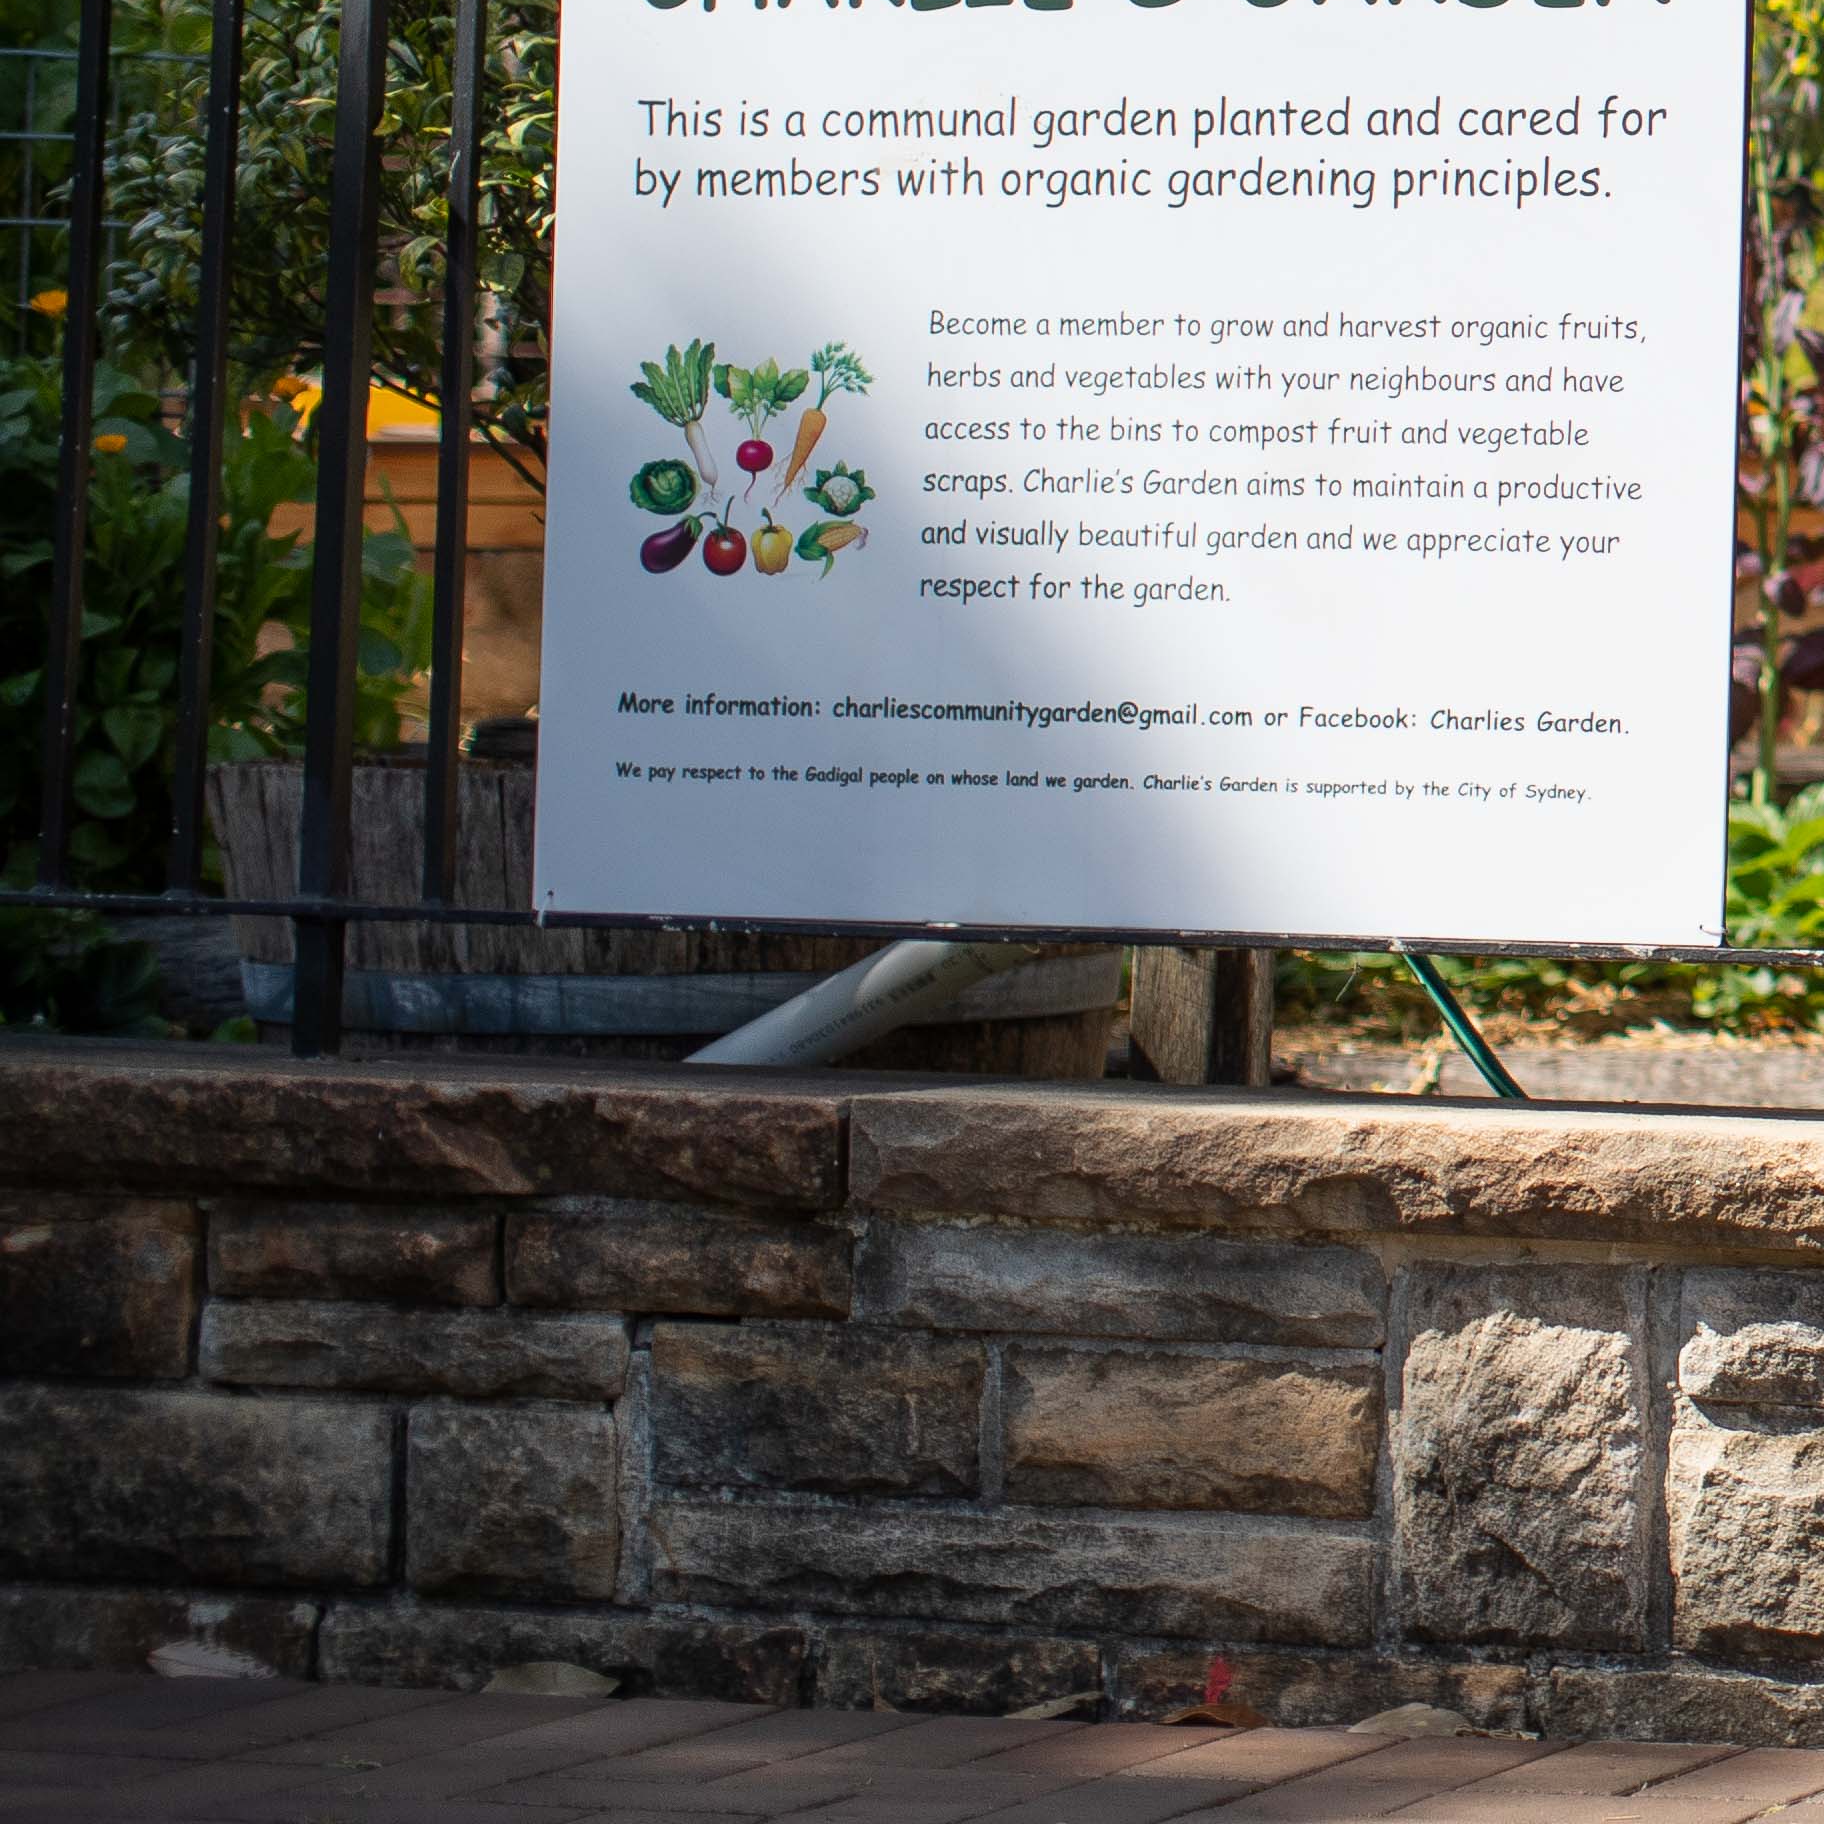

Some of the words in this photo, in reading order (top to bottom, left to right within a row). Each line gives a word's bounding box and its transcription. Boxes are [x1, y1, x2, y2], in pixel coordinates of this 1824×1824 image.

[636, 96, 723, 138] This
[739, 99, 770, 138] is
[784, 110, 807, 138] a
[821, 95, 1017, 139] communal
[1031, 95, 1177, 150] garden
[1193, 95, 1351, 150] planted
[1366, 95, 1441, 137] and
[1458, 94, 1581, 137] cared
[1596, 94, 1668, 139] for
[635, 156, 683, 209] by
[696, 156, 881, 199] members
[896, 155, 984, 197] with
[1000, 157, 1153, 209] organic
[1167, 154, 1376, 210] gardening
[1393, 154, 1612, 211] principles.
[929, 309, 1028, 337] Become
[1035, 318, 1051, 336] a
[1059, 310, 1165, 337] member
[1172, 313, 1201, 337] to
[1209, 319, 1275, 345] grow
[1282, 311, 1329, 338] and
[1339, 311, 1443, 339] harvest
[1450, 313, 1549, 347] organic
[1557, 312, 1646, 344] fruits,
[927, 360, 1002, 389] herbs
[1009, 361, 1056, 389] and
[1064, 362, 1207, 397] vegetables
[1215, 363, 1272, 391] with
[1280, 371, 1341, 399] your
[1349, 364, 1497, 400] neighbours
[1505, 365, 1553, 393] and
[1562, 365, 1625, 393] have
[924, 420, 1011, 441] access
[1018, 416, 1047, 441] to
[1055, 414, 1102, 441] the
[1110, 415, 1163, 442] bins
[1170, 418, 1199, 443] to
[1208, 419, 1319, 452] compost
[1327, 416, 1393, 446] fruit
[1401, 417, 1449, 445] and
[1457, 418, 1590, 454] vegetable
[922, 472, 1014, 501] scraps.
[1023, 466, 1135, 495] Charlie's
[1143, 468, 1238, 496] Garden
[1246, 471, 1305, 498] aims
[1314, 472, 1343, 497] to
[1352, 472, 1465, 499] maintain
[1473, 480, 1489, 499] a
[1497, 472, 1643, 508] productive
[920, 517, 967, 546] and
[975, 519, 1070, 555] visually
[1077, 519, 1197, 550] beautiful
[1205, 522, 1298, 557] garden
[1306, 523, 1353, 551] and
[1362, 532, 1398, 551] we
[1406, 527, 1552, 560] appreciate
[1559, 535, 1621, 562] your
[919, 574, 1021, 606] respect
[1028, 571, 1072, 601] for
[1079, 572, 1126, 600] the
[1132, 574, 1231, 609] garden.
[617, 691, 675, 715] More
[685, 691, 821, 718] information:
[831, 695, 1253, 731] charliescommunitygarden@gmail.com
[1263, 711, 1289, 728] or
[1299, 705, 1417, 729] Facebook:
[1429, 707, 1526, 732] Charlies
[1536, 710, 1630, 735] Garden.
[615, 761, 643, 778] We
[647, 765, 677, 783] pay
[681, 765, 743, 785] respect
[747, 765, 766, 782] to
[770, 764, 799, 782] the
[804, 765, 863, 788] Gadigal
[869, 767, 920, 789] people
[925, 772, 945, 786] on
[950, 768, 999, 787] whose
[1005, 769, 1039, 788] land
[1044, 775, 1067, 788] we
[1072, 772, 1135, 793] garden.
[1142, 773, 1213, 792] Charlie's
[1219, 775, 1279, 793] Garden
[1285, 777, 1299, 794] is
[1305, 779, 1388, 799] supported
[1394, 779, 1415, 801] by
[1421, 780, 1451, 797] the
[1457, 781, 1492, 803] City
[1498, 782, 1518, 799] of
[1524, 783, 1592, 805] Sydney.
